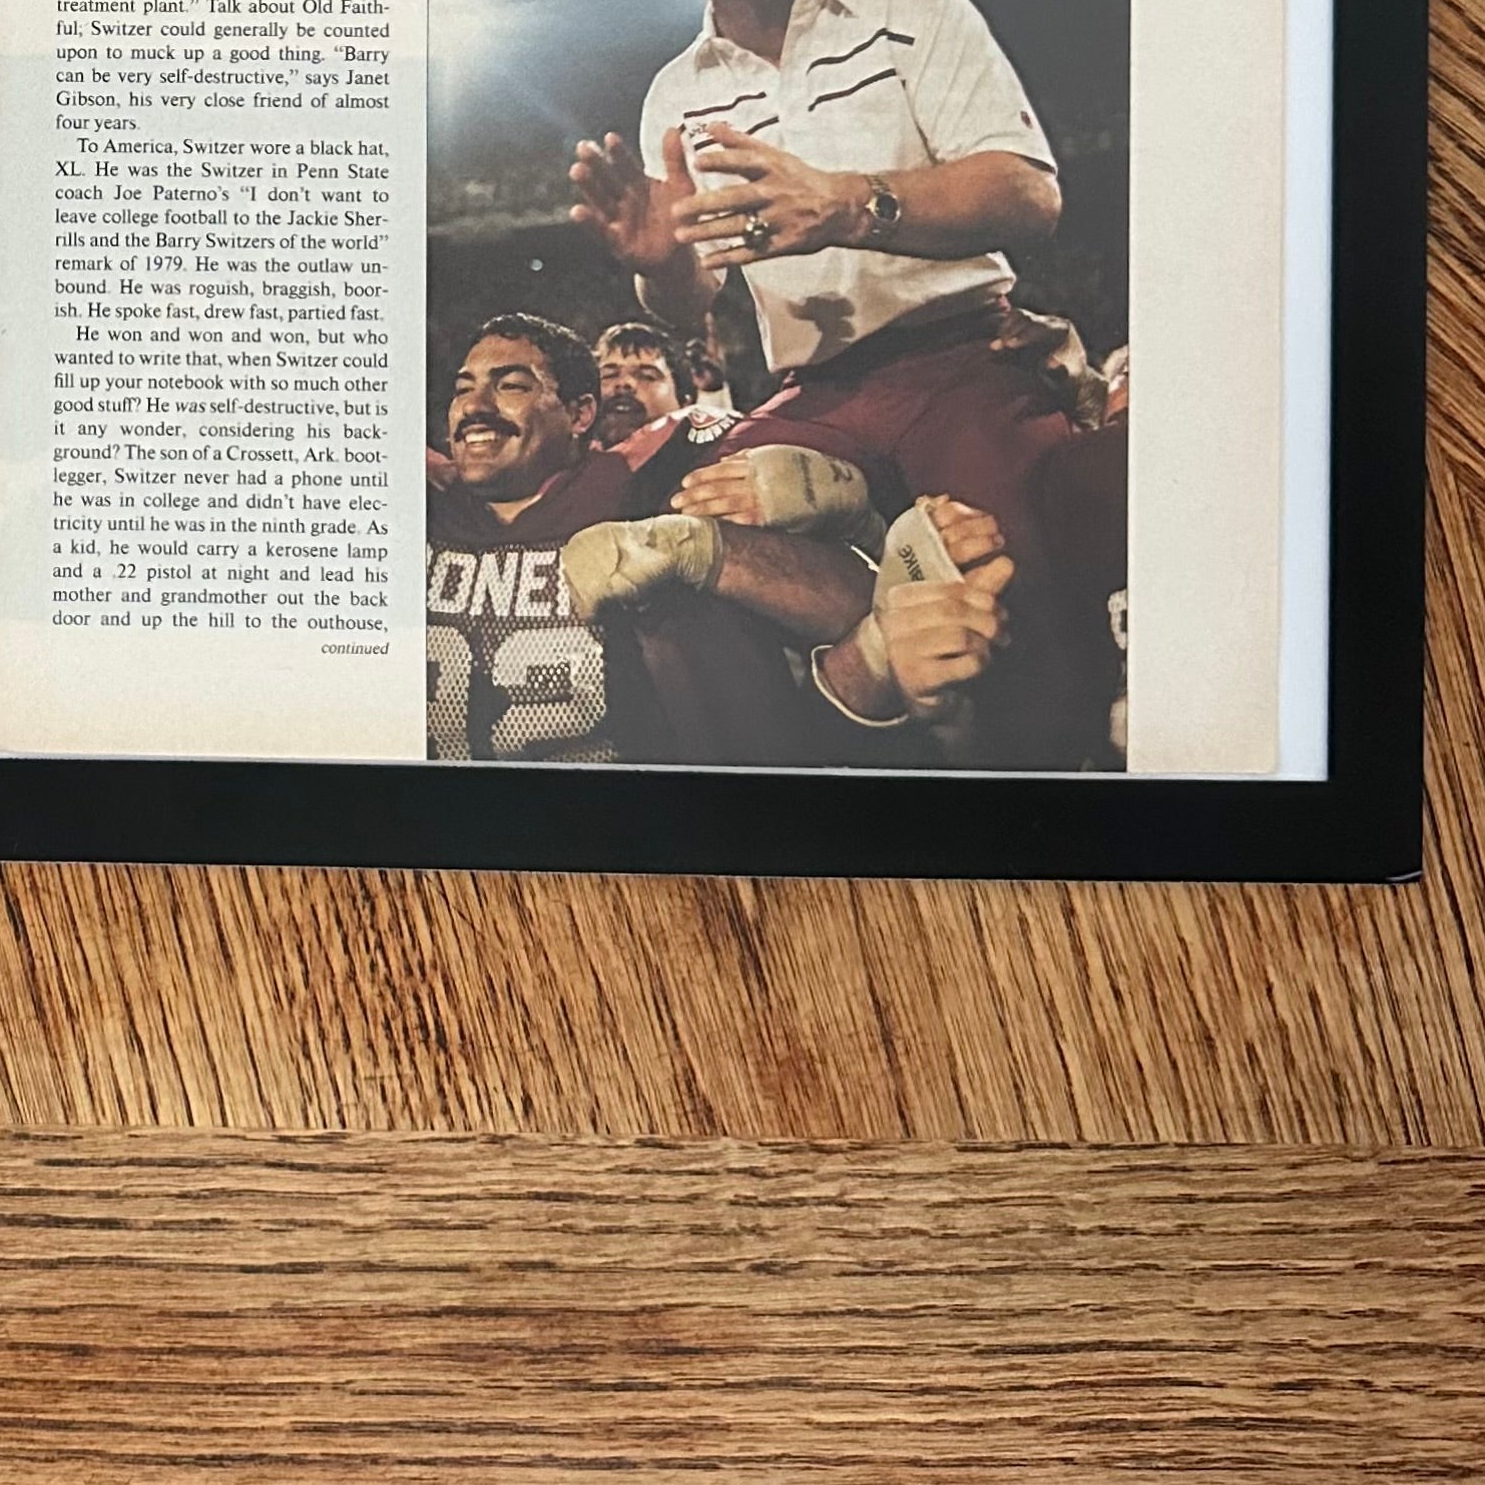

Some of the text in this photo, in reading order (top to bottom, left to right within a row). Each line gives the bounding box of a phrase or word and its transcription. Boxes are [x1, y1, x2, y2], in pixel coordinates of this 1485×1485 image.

[56, 90, 389, 110] Gibson, his very close friend of almost
[55, 278, 389, 300] bound. He was roguish, braggish, boor-
[53, 467, 388, 489] legger, Switzer never had a phone until
[427, 547, 571, 617] ONE
[53, 587, 388, 607] mother and grandmother out the back
[320, 640, 391, 656] continued
